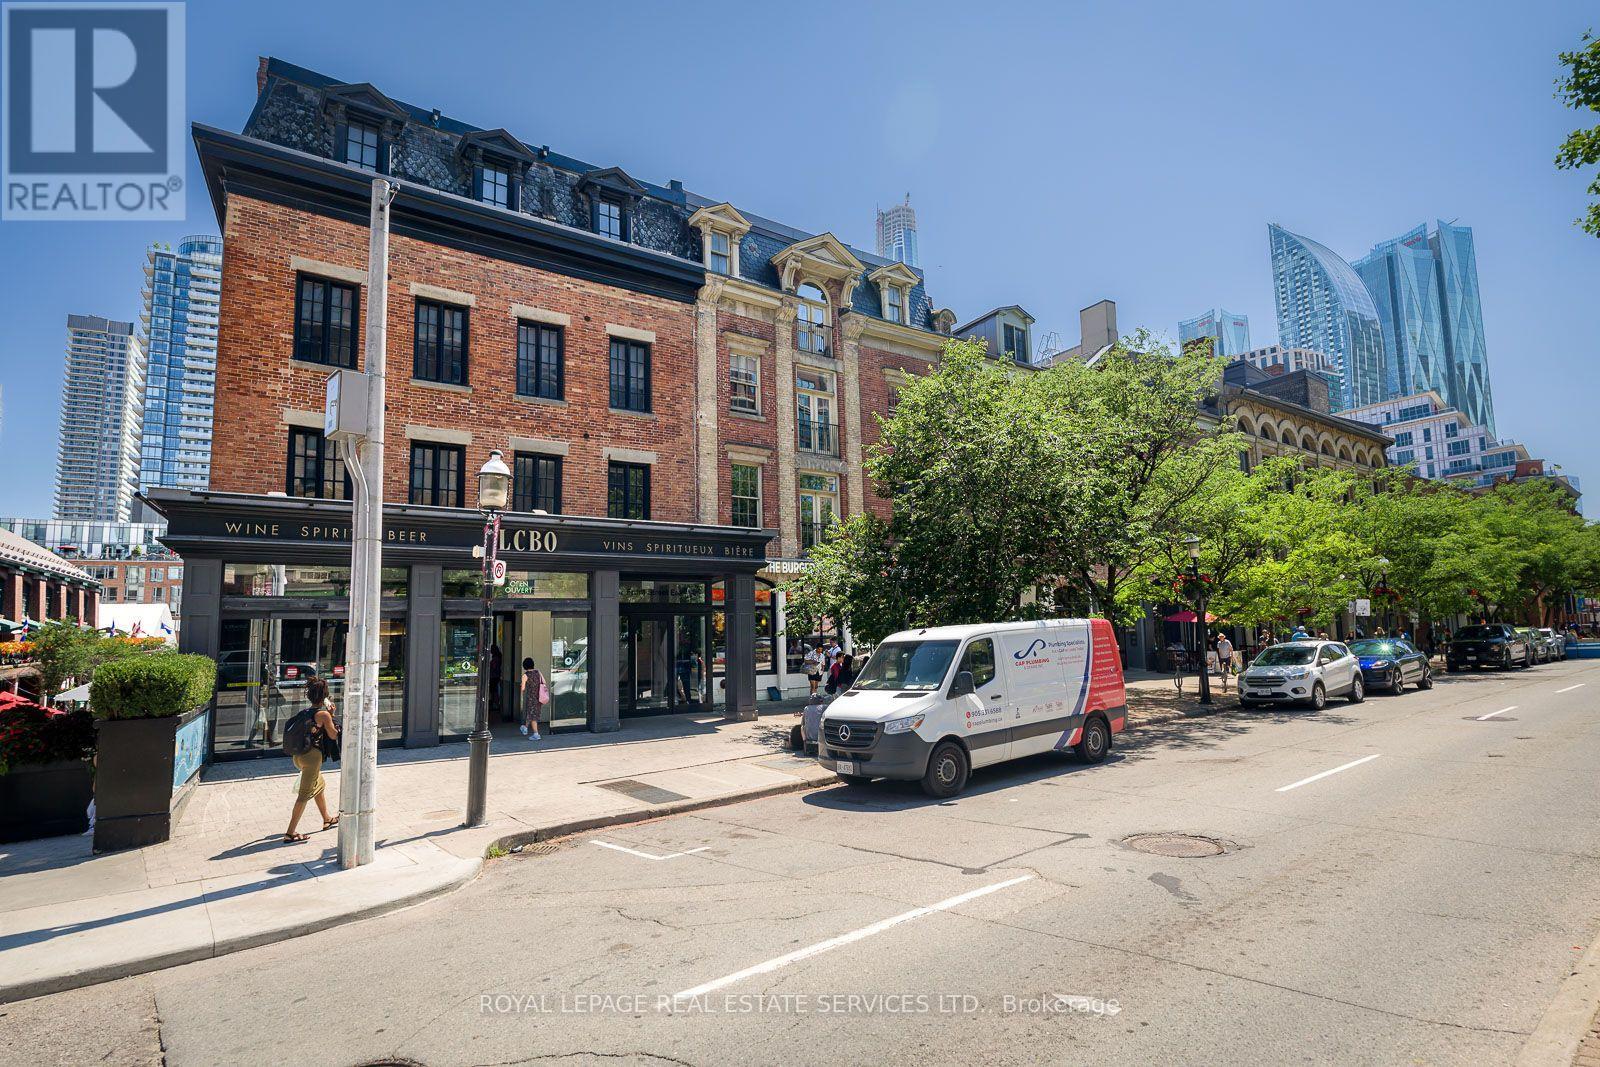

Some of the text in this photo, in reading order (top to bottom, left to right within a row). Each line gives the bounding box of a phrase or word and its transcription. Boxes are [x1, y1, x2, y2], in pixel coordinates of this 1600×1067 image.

[225, 522, 427, 542] WINE SPIRI BEER
[498, 528, 558, 553] LCBO
[603, 541, 754, 557] VINS SPIRITUEUX BIÈRE
[1025, 657, 1050, 665] PLUMBING
